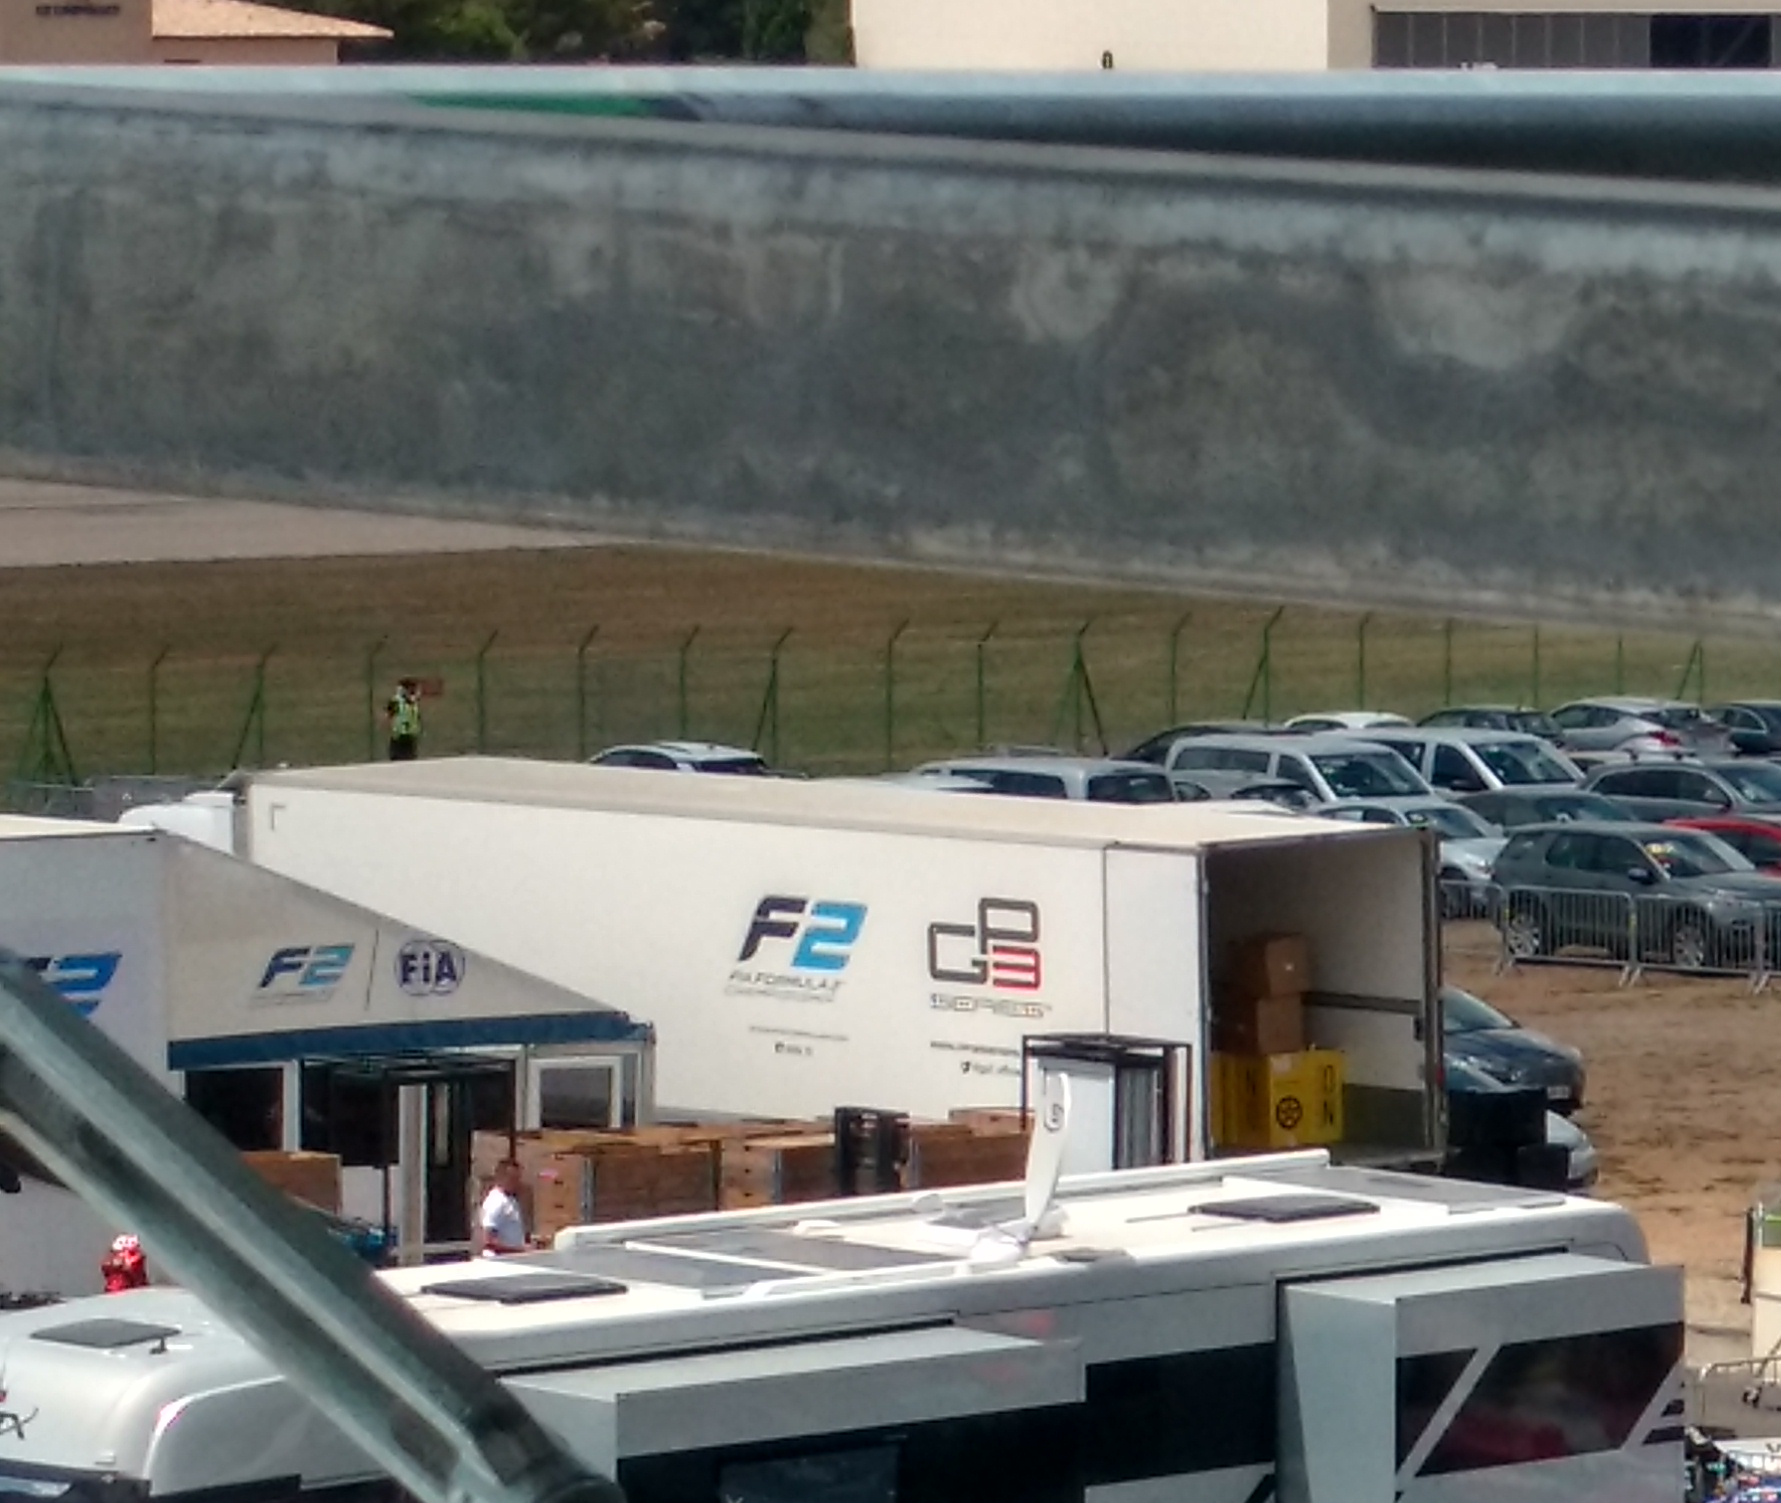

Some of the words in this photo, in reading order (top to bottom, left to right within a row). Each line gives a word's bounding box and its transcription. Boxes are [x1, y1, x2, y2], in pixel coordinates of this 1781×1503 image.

[739, 896, 868, 970] F2
[24, 953, 122, 1015] 2
[258, 944, 355, 989] F2
